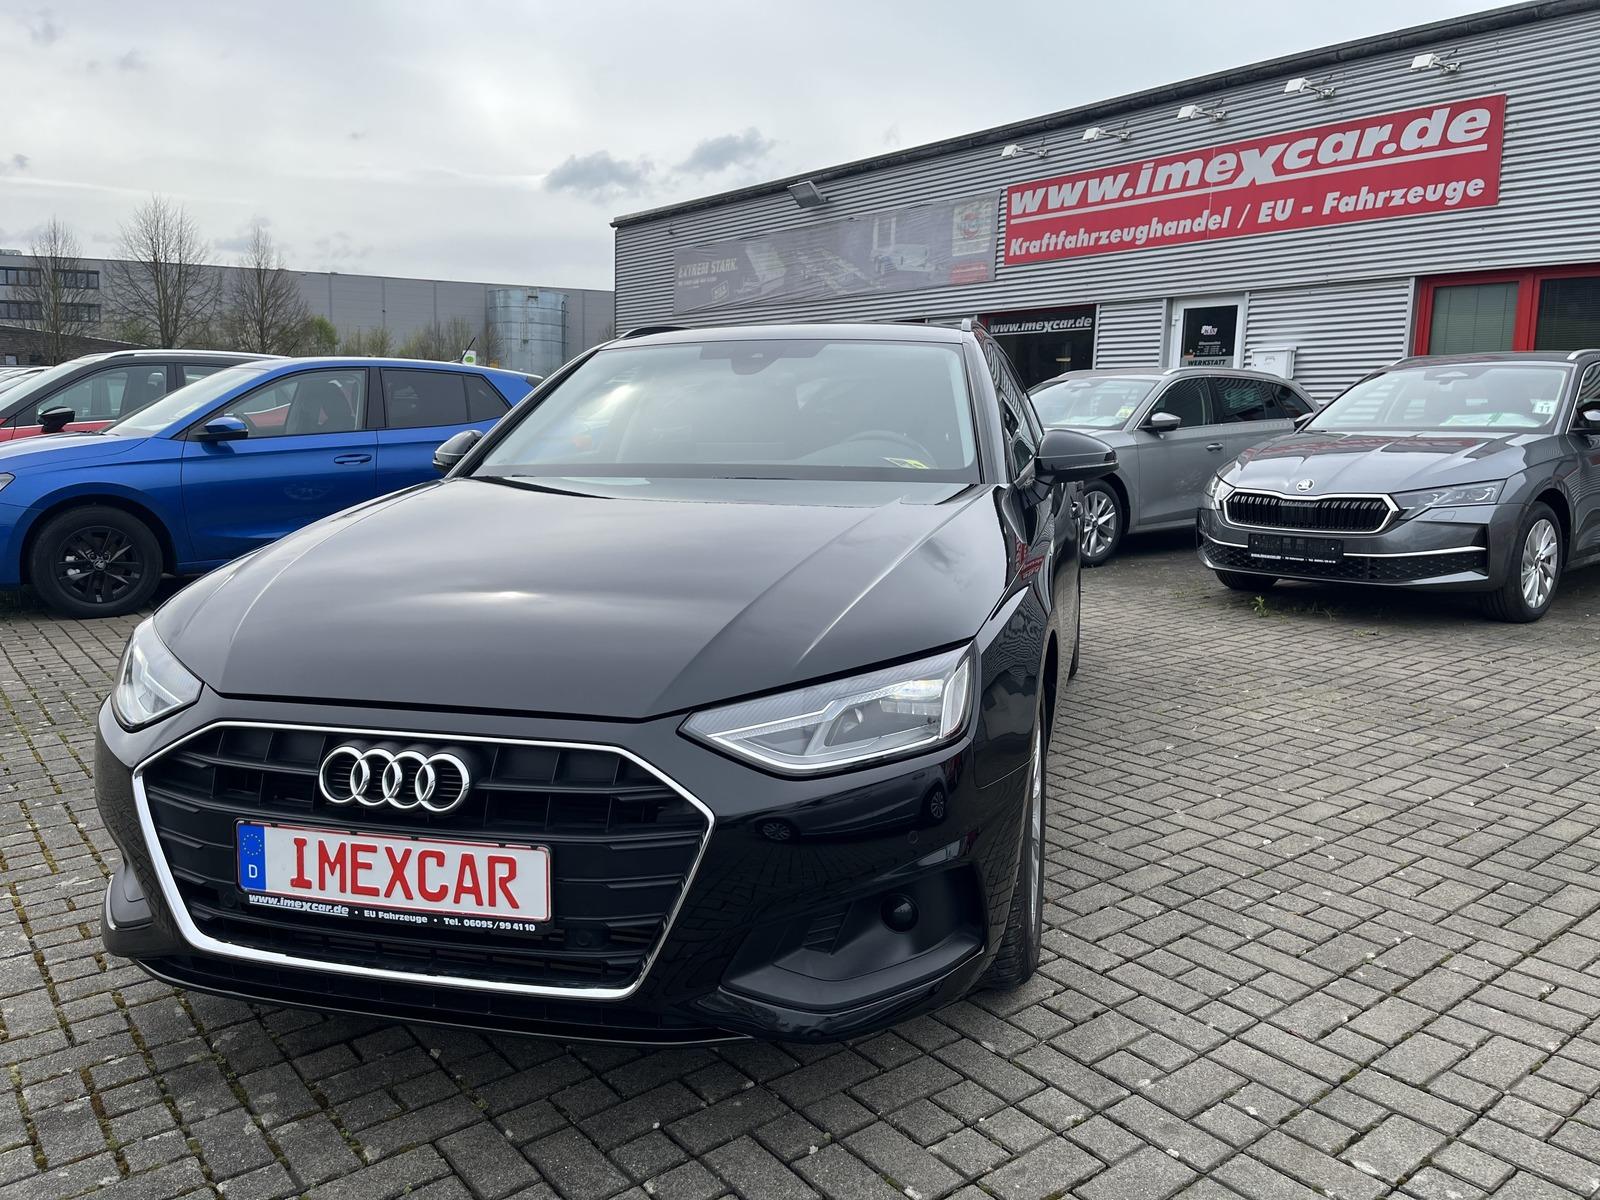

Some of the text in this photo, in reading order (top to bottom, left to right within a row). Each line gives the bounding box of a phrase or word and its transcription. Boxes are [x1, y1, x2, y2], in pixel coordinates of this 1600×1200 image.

[1009, 206, 1232, 256] Kraftfahrzeughandel
[1237, 204, 1251, 229] /
[1257, 198, 1295, 224] EU
[1301, 205, 1313, 214] -
[1322, 178, 1485, 216] Fahrzeuge
[248, 863, 258, 879] D
[289, 836, 520, 909] IMEXCAR
[364, 909, 376, 918] EU
[378, 911, 428, 924] Fahrzeuge
[443, 917, 461, 926] Tel.
